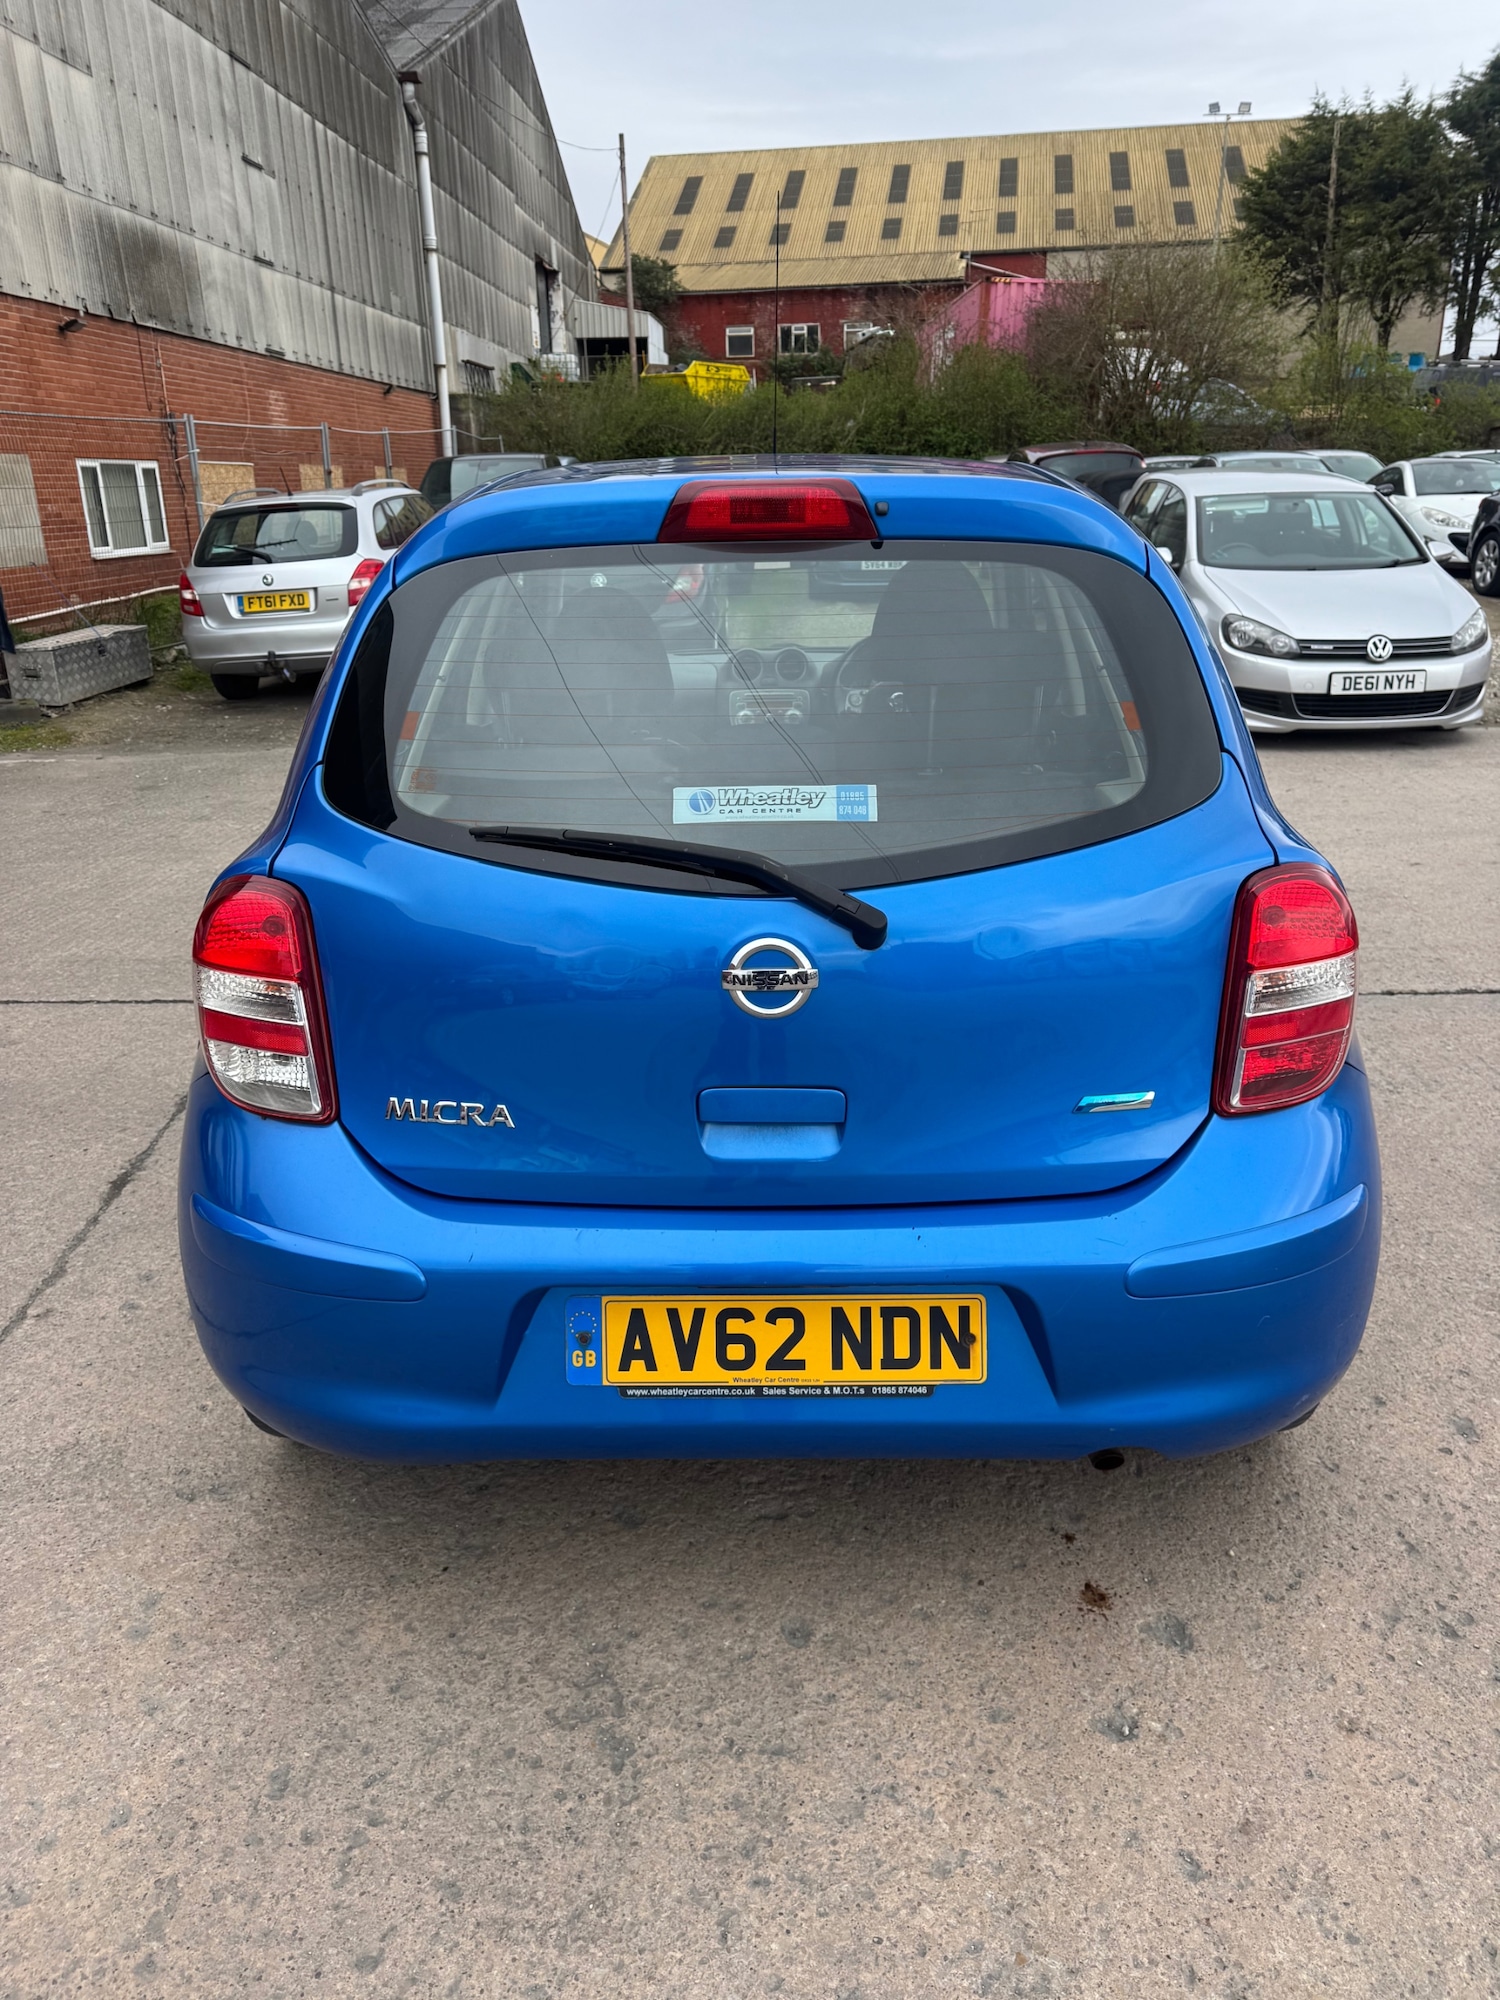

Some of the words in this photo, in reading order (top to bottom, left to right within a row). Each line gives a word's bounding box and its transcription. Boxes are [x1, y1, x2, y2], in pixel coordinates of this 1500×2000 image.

[247, 595, 277, 609] FT61
[279, 593, 306, 607] FXD
[1341, 675, 1380, 691] DE61
[1383, 673, 1417, 690] NYH
[718, 787, 827, 808] Wheatley
[838, 805, 852, 815] 874
[732, 971, 809, 986] NISSAN
[385, 1096, 515, 1128] MICRA
[617, 1306, 806, 1372] AV62
[831, 1305, 971, 1371] NDN
[572, 1350, 596, 1367] GB
[626, 1387, 755, 1397] www.wheatleycarcentre.co.uk
[762, 1387, 786, 1395] Sales
[788, 1386, 821, 1395] Service
[823, 1387, 831, 1395] &
[833, 1386, 865, 1395] M.O.T.s
[871, 1386, 896, 1394] 01865
[898, 1386, 927, 1394] 874046
